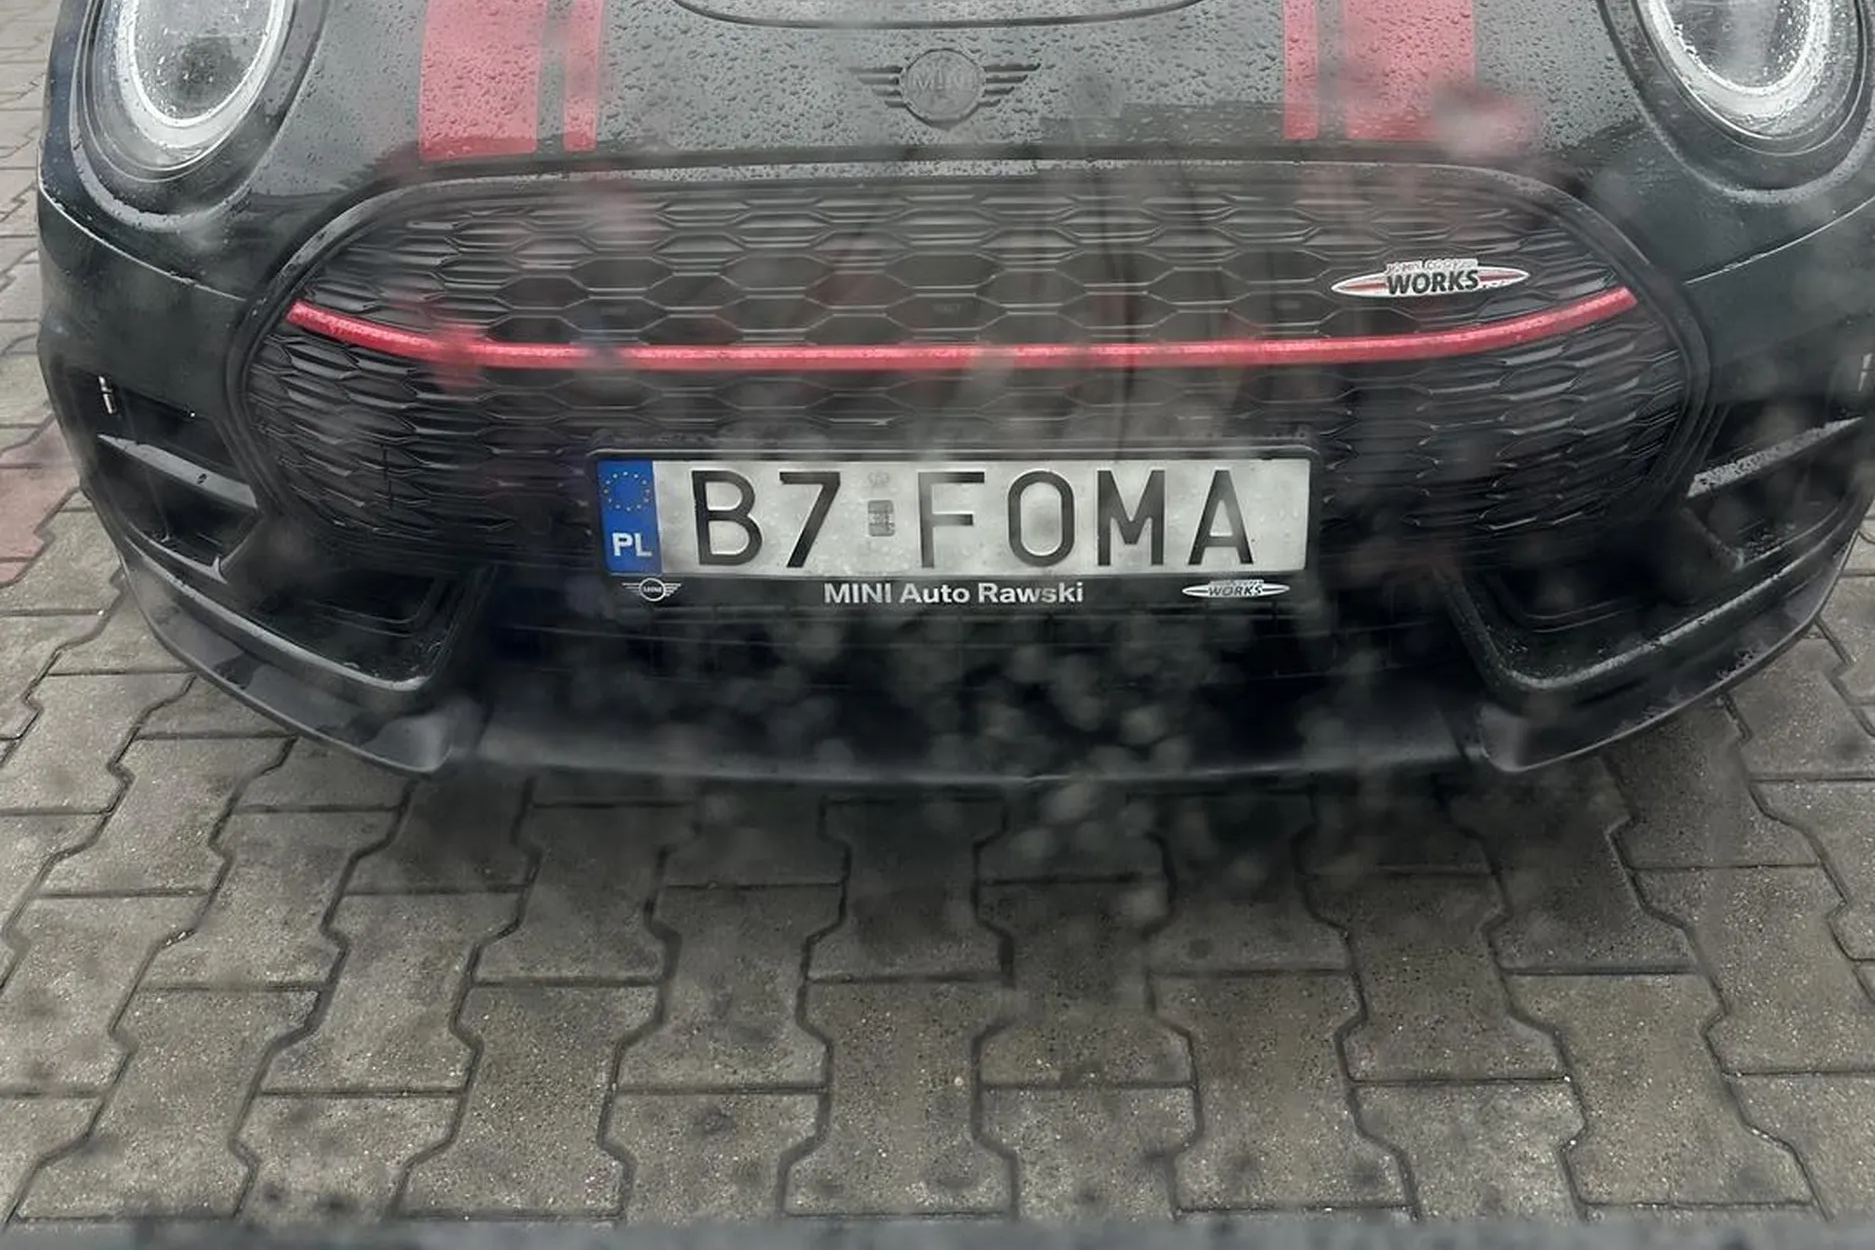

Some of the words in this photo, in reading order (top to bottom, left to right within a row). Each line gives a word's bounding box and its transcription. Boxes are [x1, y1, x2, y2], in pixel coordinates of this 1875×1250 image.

[1387, 269, 1478, 294] WORKS
[691, 469, 841, 568] B7
[918, 469, 1254, 568] FOMA
[612, 532, 653, 558] PL
[823, 582, 892, 604] MINI
[900, 582, 971, 604] Auto
[977, 581, 1084, 603] Rawski
[1208, 585, 1263, 596] WORKS
